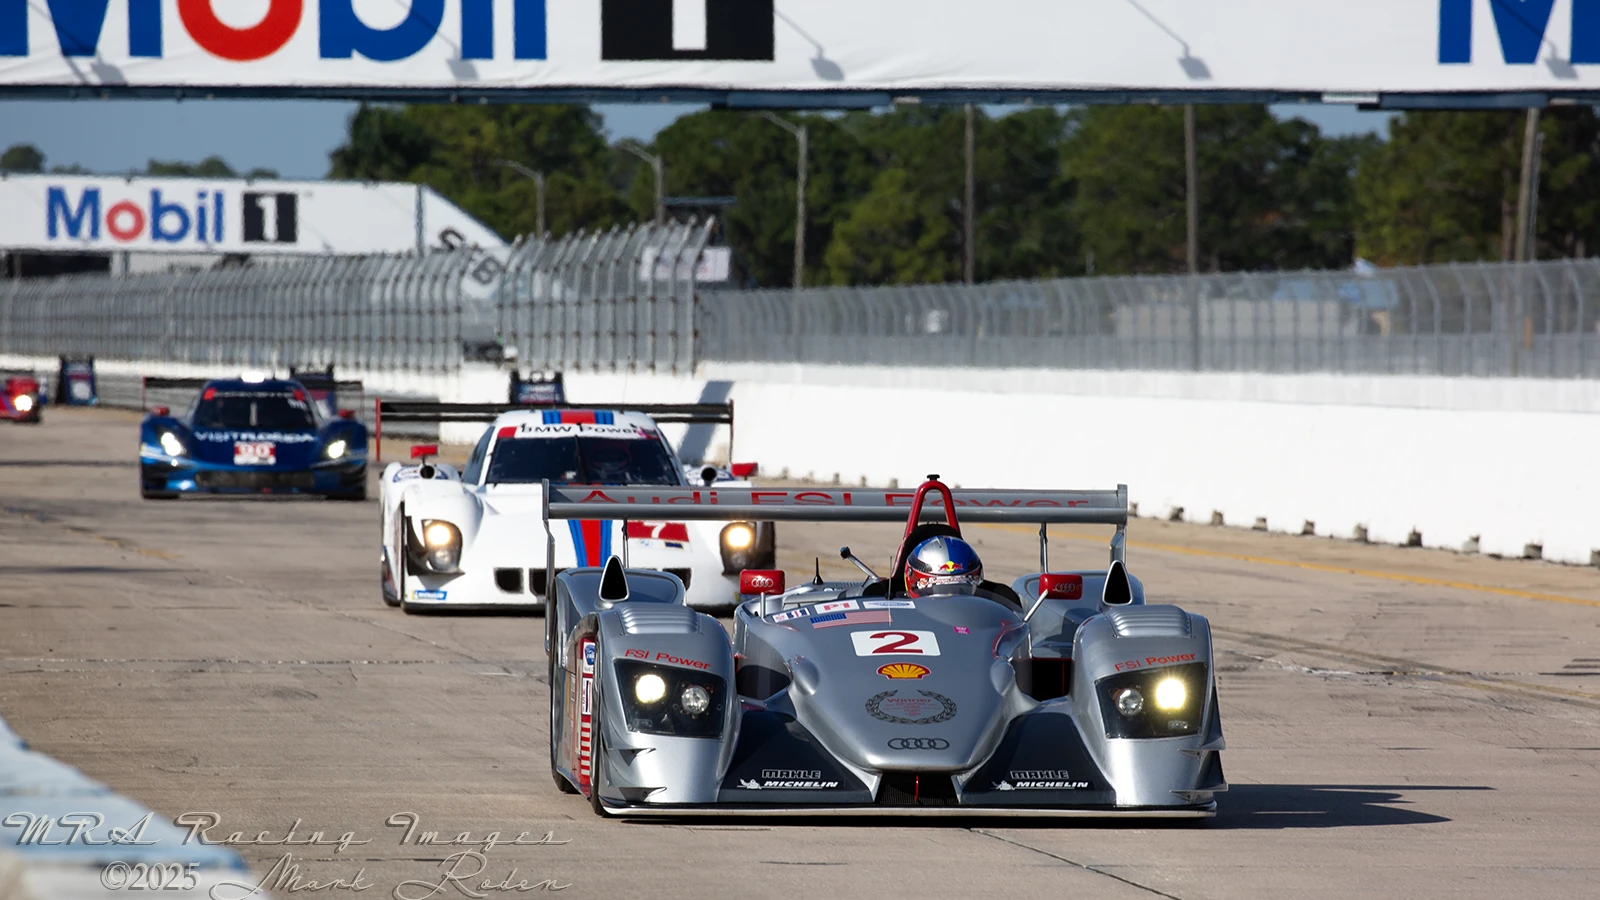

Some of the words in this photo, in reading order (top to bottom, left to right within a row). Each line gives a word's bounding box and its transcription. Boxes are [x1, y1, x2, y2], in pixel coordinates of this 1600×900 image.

[47, 186, 224, 242] Mobil
[256, 195, 277, 241] 1
[520, 422, 571, 434] BMW
[578, 422, 639, 435] Power
[751, 492, 853, 505] FSI
[643, 520, 667, 538] 7
[869, 631, 924, 654] 2
[625, 648, 650, 659] FSI
[655, 651, 711, 670] Power
[1113, 659, 1142, 672] FSI
[1145, 652, 1196, 666] Power
[761, 768, 821, 780] MAHLE
[1009, 769, 1070, 780] MAHLE
[763, 780, 839, 788] MICHELIN
